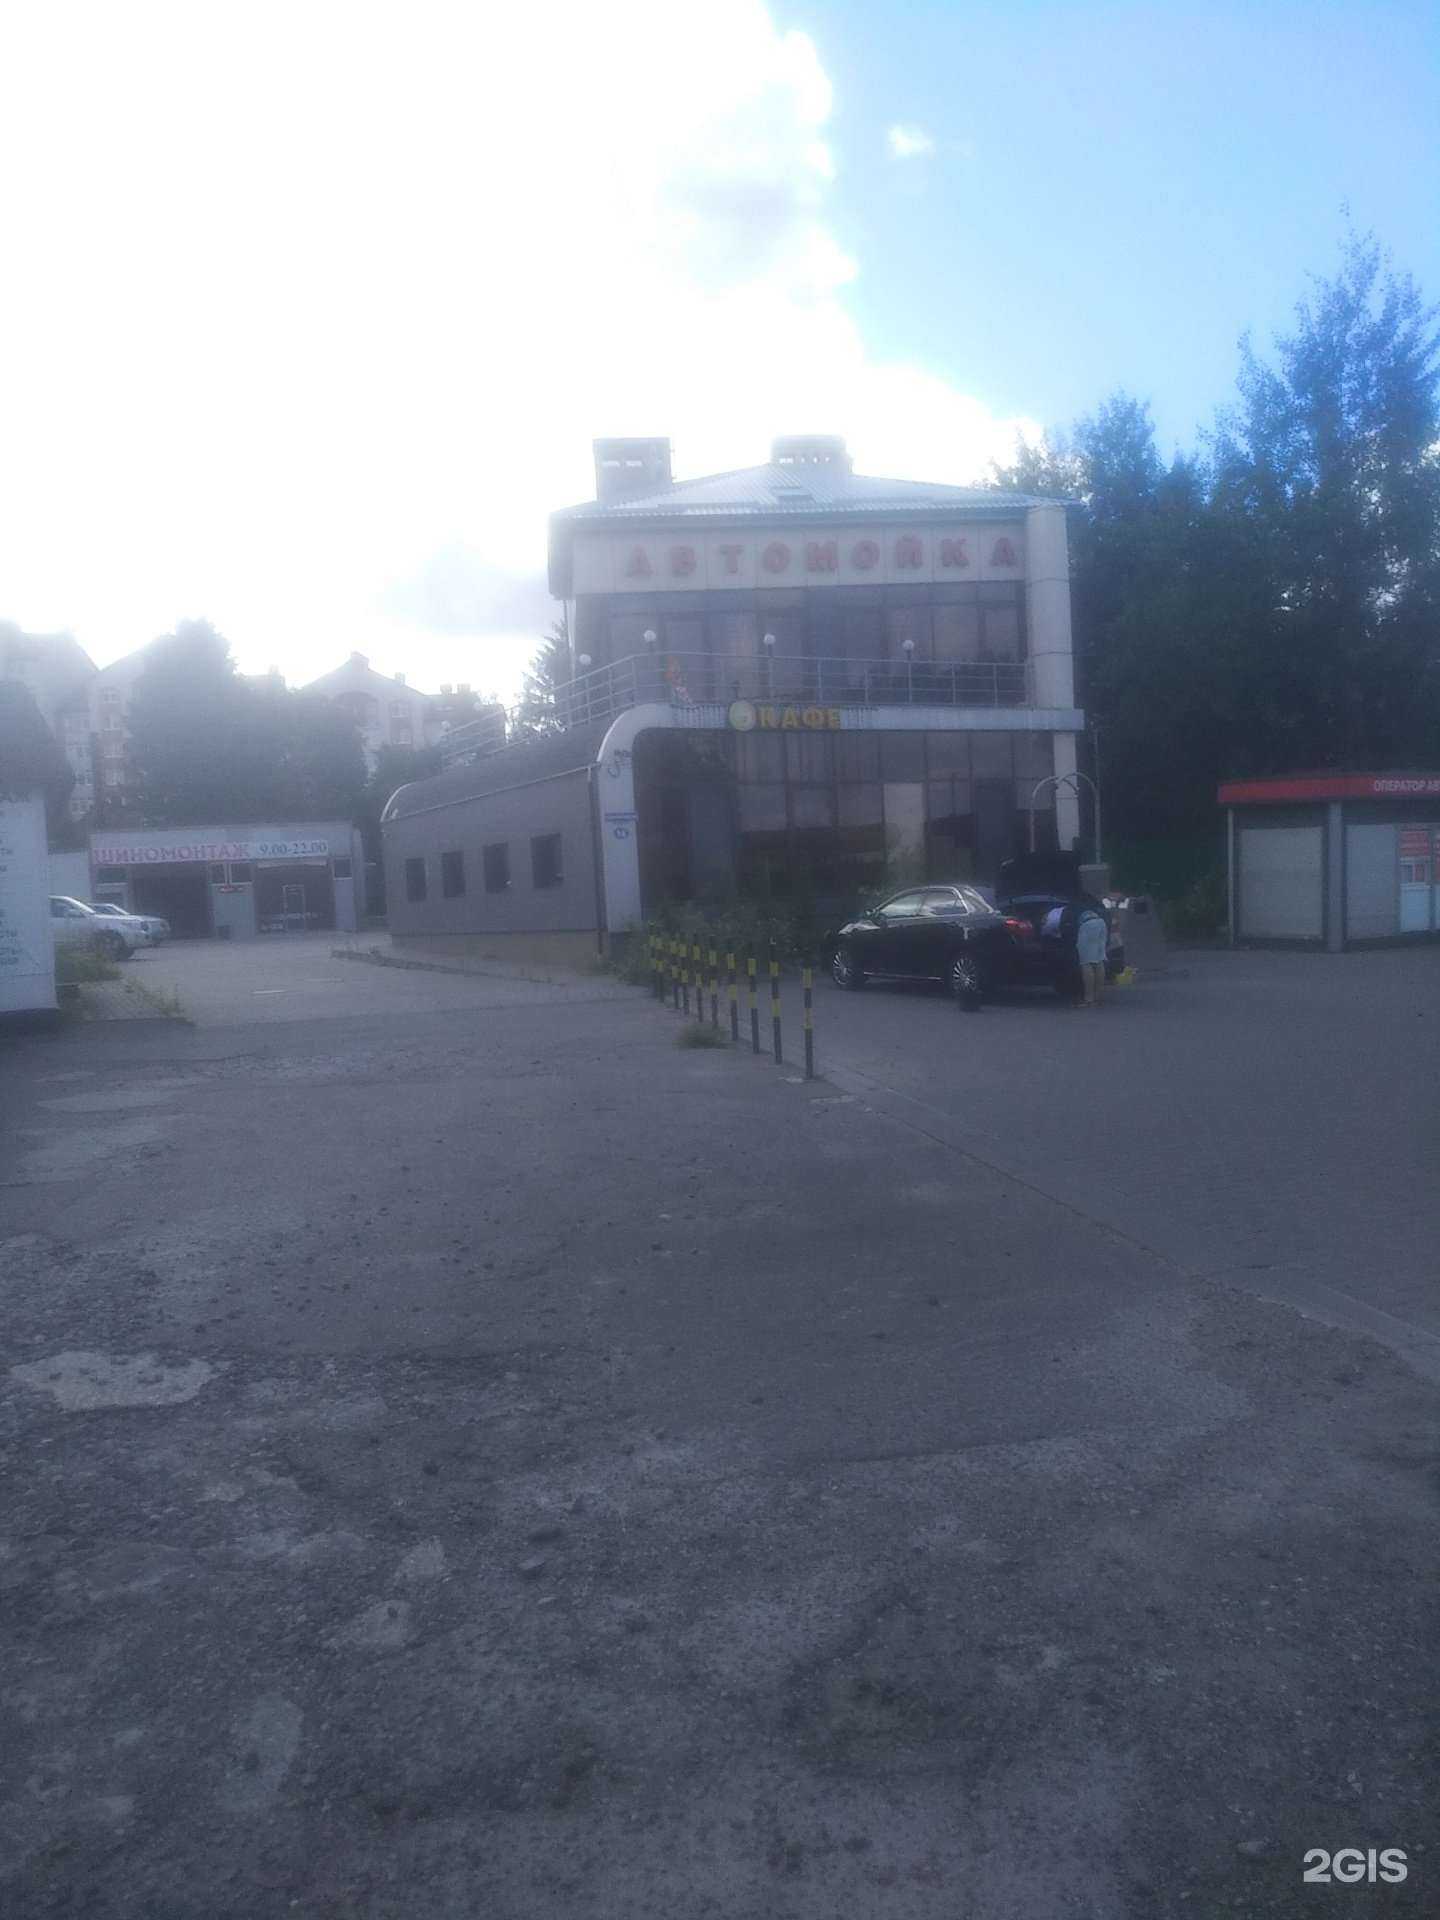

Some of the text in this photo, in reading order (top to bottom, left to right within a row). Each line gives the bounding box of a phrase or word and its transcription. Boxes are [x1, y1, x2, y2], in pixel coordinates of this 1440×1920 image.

[627, 535, 1018, 576] АВТОМОЙКА
[759, 706, 840, 729] КАФЕ
[1374, 780, 1425, 792] ОПЕРАТОР
[97, 840, 327, 863] ШИНОМОНТАЖ 9.00-22.00
